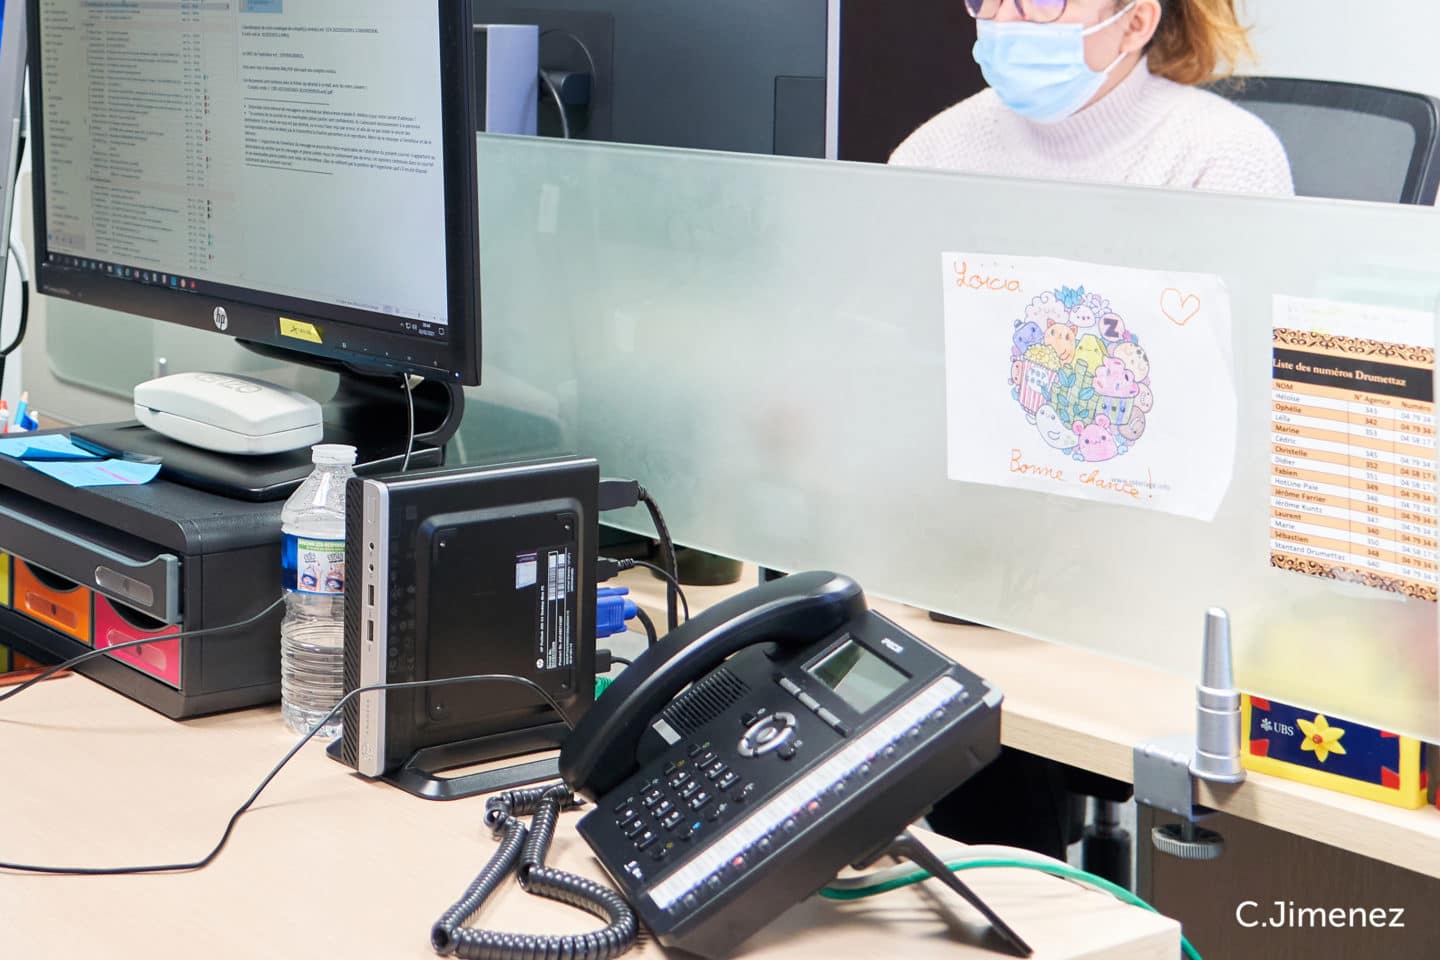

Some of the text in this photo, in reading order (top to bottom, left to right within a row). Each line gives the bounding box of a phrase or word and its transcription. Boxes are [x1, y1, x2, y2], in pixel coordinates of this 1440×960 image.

[1273, 359, 1406, 387] Liste des numéros Drumettaz
[1275, 382, 1293, 390] NOM
[1275, 425, 1299, 434] Marine
[1275, 467, 1298, 477] Fabien
[1275, 510, 1301, 520] Laurent
[1275, 521, 1295, 530] Marie
[1273, 722, 1294, 737] UBS
